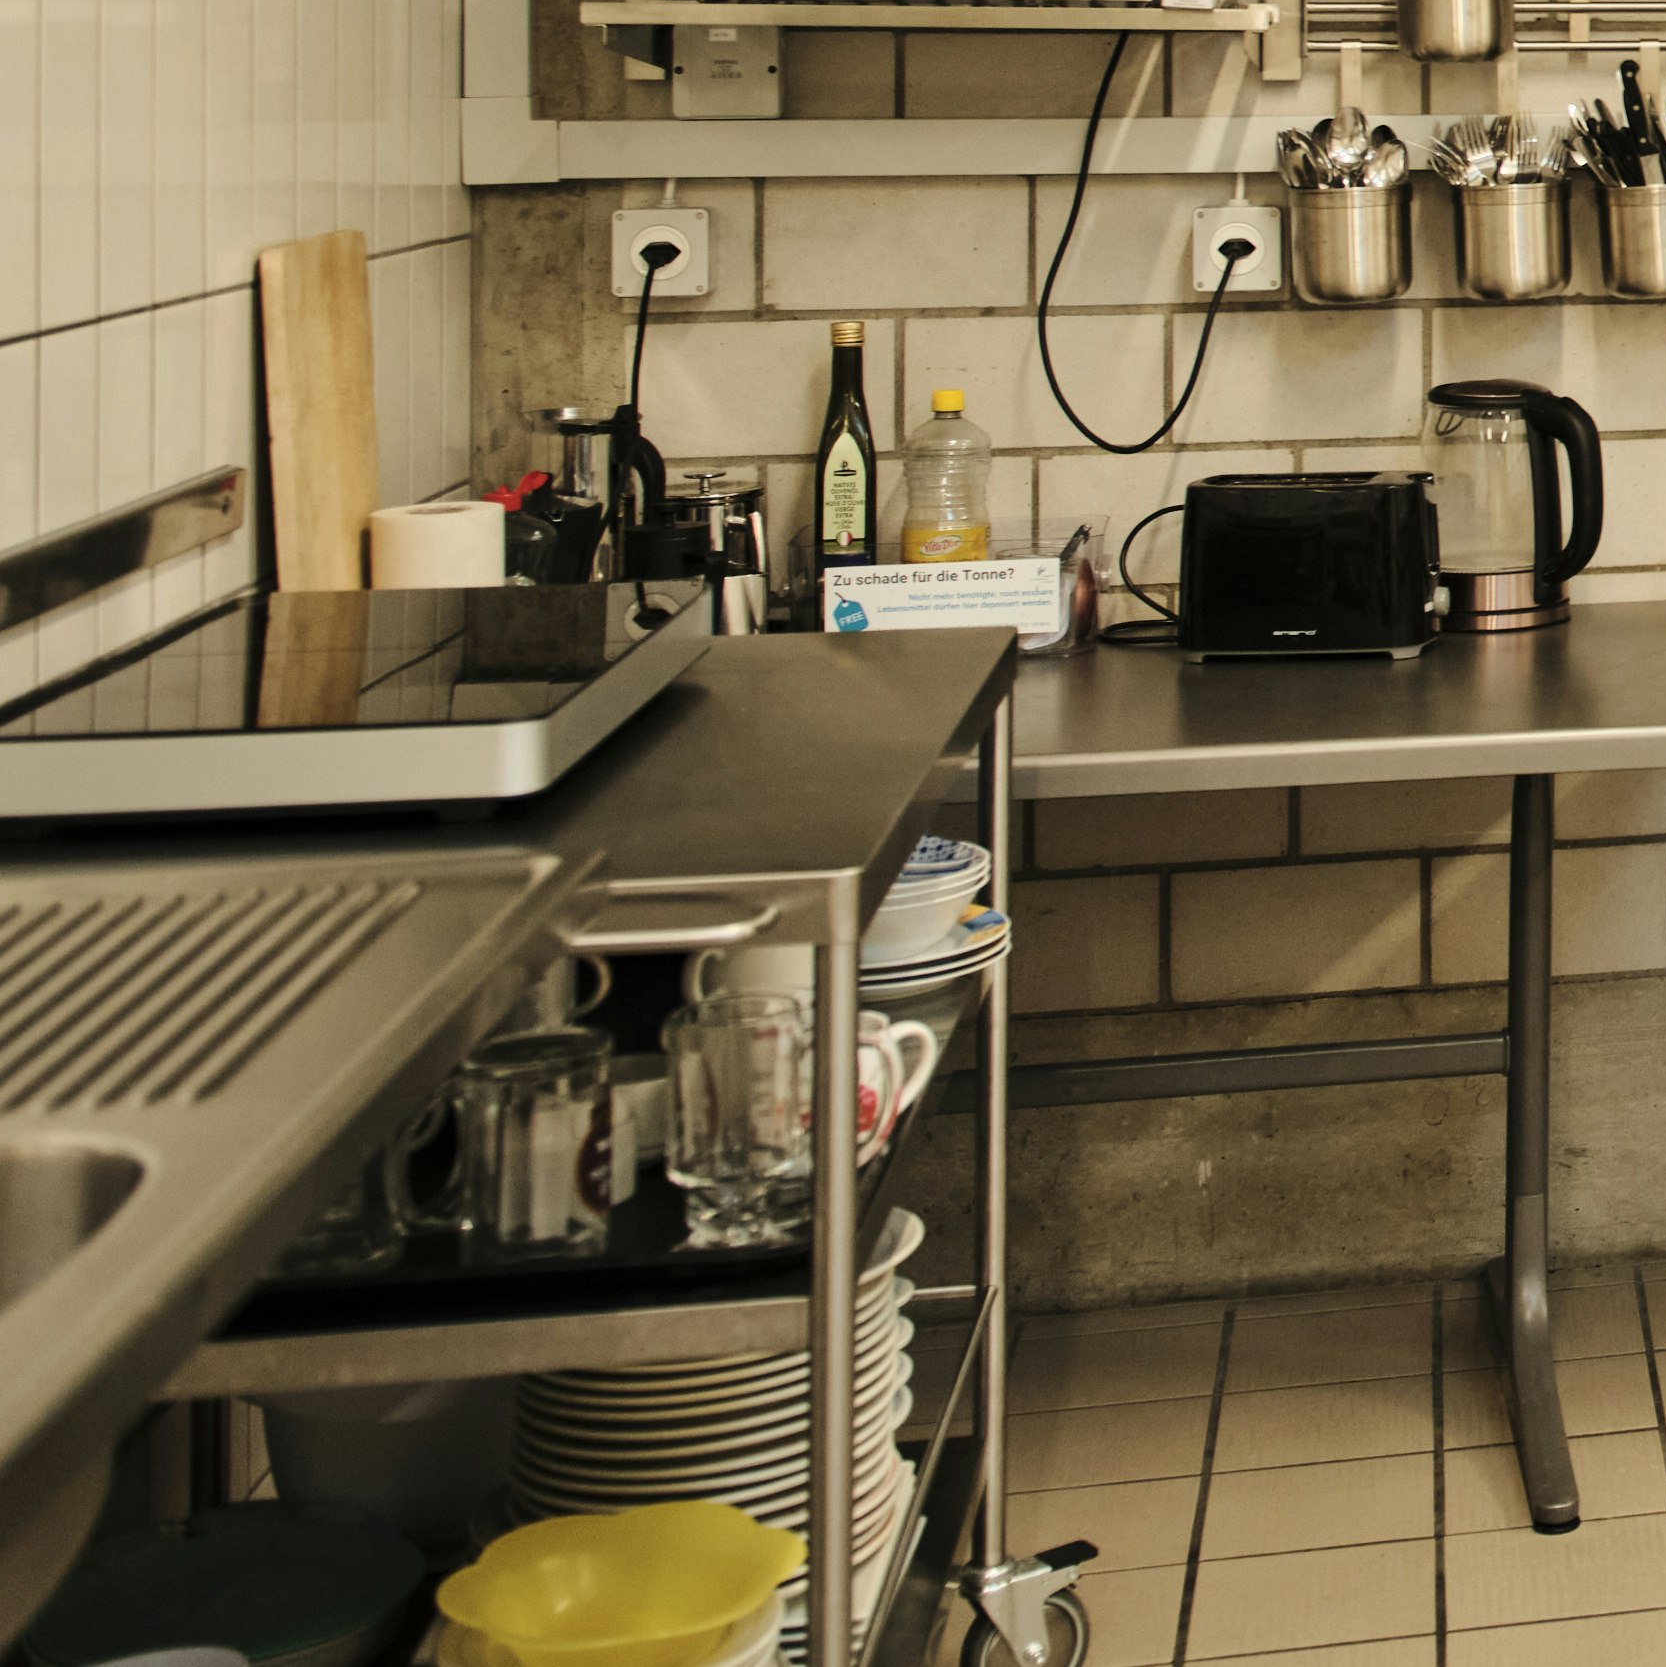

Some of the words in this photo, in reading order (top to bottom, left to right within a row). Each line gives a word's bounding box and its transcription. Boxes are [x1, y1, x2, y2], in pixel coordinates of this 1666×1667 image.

[833, 575, 851, 586] Zu
[855, 572, 908, 585] schade
[912, 570, 933, 583] für
[936, 570, 958, 582] die
[962, 567, 1015, 581] Tonne?
[908, 593, 930, 601] Nicht
[932, 592, 954, 600] mehr
[877, 604, 932, 613] Lebensmittel
[932, 602, 961, 610] dürfen
[980, 601, 1020, 609] deponiert
[839, 610, 865, 626] FREE
